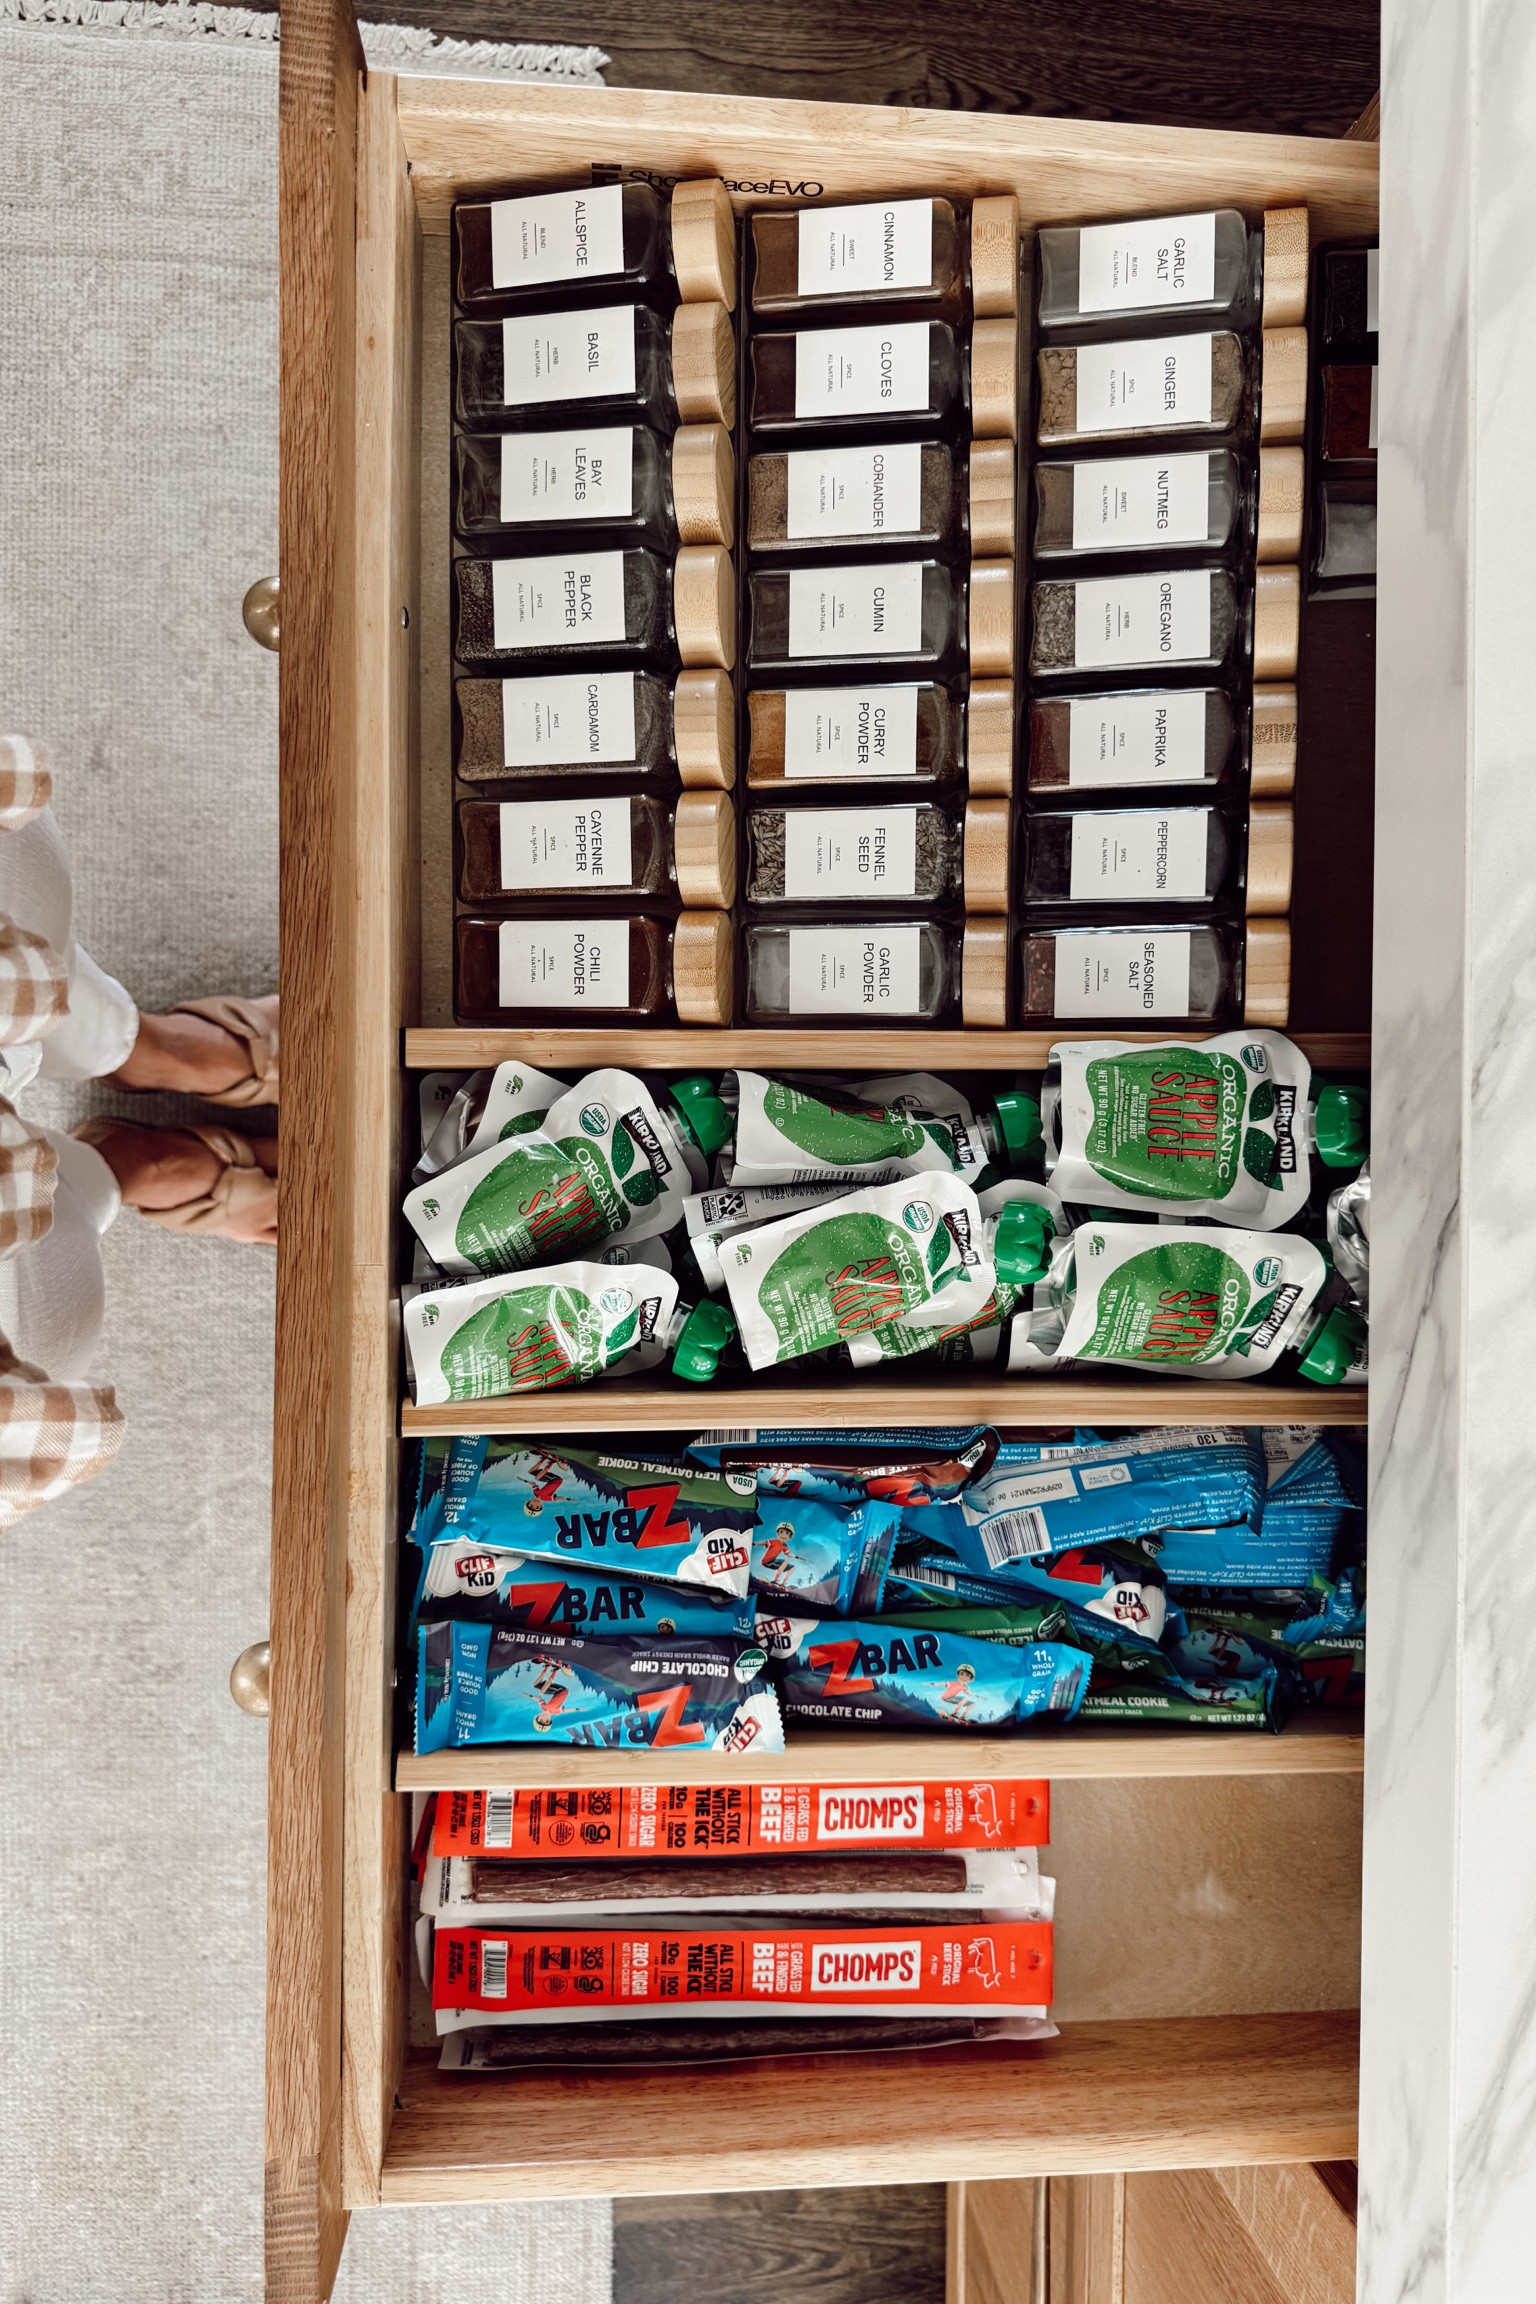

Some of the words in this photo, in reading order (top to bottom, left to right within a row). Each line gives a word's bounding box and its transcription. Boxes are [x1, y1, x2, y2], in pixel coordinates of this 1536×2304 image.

[539, 227, 547, 249] BLEND
[574, 200, 588, 267] ALLSPICE
[883, 211, 895, 282] CINNAMON
[1156, 248, 1169, 282] SALT
[1172, 237, 1186, 289] GARLIC
[587, 332, 600, 373] BASIL
[880, 341, 893, 398] CLOVES
[1163, 356, 1177, 412] GINGER
[574, 447, 587, 501] LEAVES
[590, 459, 603, 487] BAY
[871, 454, 885, 529] CORIANDER
[1120, 491, 1128, 513] SWEET
[1156, 470, 1169, 530] NUTMEG
[563, 570, 577, 629] PEPPER
[579, 574, 593, 622] BLACK
[873, 586, 886, 633] CUMIN
[1159, 582, 1172, 653] OREGANO
[587, 684, 601, 753] CARDAMOM
[1099, 722, 1107, 733] ALL
[857, 701, 870, 765] POWDER
[873, 707, 886, 758] CURRY
[1118, 732, 1126, 747] SPICE
[1154, 708, 1167, 768] PAPRIKA
[1099, 734, 1107, 761] NATURAL
[549, 835, 557, 852] SPICE
[574, 815, 588, 872] PEPPER
[590, 809, 604, 877] CAYENNE
[858, 835, 871, 873] SEED
[873, 827, 886, 882] FENNEL
[1155, 820, 1169, 889] PEPPERCORN
[573, 933, 586, 996] POWDER
[589, 946, 601, 982] CHILI
[862, 942, 875, 1003] POWDER
[878, 947, 891, 998] GARLIC
[1102, 967, 1110, 983] SPICE
[1128, 960, 1140, 991] SALT
[1143, 941, 1155, 1010] SEASONED
[1097, 1070, 1108, 1083] NET
[1098, 1085, 1108, 1096] WT
[1131, 1085, 1139, 1094] NO
[1098, 1099, 1108, 1108] 90
[1130, 1096, 1138, 1117] SUGAR
[1137, 1093, 1147, 1135] GLUTEN-FREE
[583, 1112, 601, 1133] ORGANIC
[591, 1108, 606, 1125] USDA
[1097, 1118, 1107, 1137] (3.17
[1147, 1071, 1185, 1162] SAUCE
[1181, 1072, 1219, 1163] APPLE
[1218, 1065, 1237, 1178] ORGANIC
[1096, 1140, 1106, 1153] OZ)
[574, 1147, 623, 1232] ORGANIC
[917, 1206, 930, 1223] USDA
[1270, 1264, 1280, 1281] USDA
[770, 1290, 783, 1303] NET
[811, 1293, 821, 1302] NO
[824, 1264, 872, 1339] SAUCE
[1107, 1289, 1119, 1302] NET
[1136, 1302, 1145, 1311] NO
[773, 1304, 785, 1316] WT
[812, 1303, 824, 1320] SUGAR
[1100, 1316, 1112, 1325] 90
[1104, 1304, 1115, 1314] WT
[1131, 1311, 1143, 1331] SUGAR
[1191, 1279, 1239, 1362] ORGANIC
[778, 1318, 789, 1328] 90
[1196, 1433, 1219, 1445] 130
[597, 1456, 639, 1471] COOKIE
[641, 1462, 693, 1479] OATMEAL
[732, 1475, 753, 1489] USDA
[707, 1537, 735, 1554] KiD
[459, 1557, 495, 1575] CLIF
[710, 1550, 743, 1572] CLIF
[467, 1571, 495, 1587] KiD
[516, 1633, 526, 1642] OZ
[527, 1634, 540, 1644] 1.27
[541, 1636, 553, 1645] WT
[553, 1636, 566, 1646] NET
[756, 1618, 787, 1640] CLIF
[629, 1660, 660, 1673] CHIP
[694, 1652, 711, 1661] WHOLE
[808, 1633, 943, 1698] ZBAR
[662, 1661, 729, 1678] CHOCOLATE
[458, 1686, 479, 1696] GOOD
[1127, 1697, 1169, 1708] COOKIE
[785, 1705, 853, 1718] CHOCOLATE
[855, 1708, 882, 1720] CHIP
[1207, 1714, 1220, 1723] NET
[1221, 1714, 1232, 1723] WT
[641, 1787, 657, 1812] ZERO
[695, 1787, 711, 1818] THE
[726, 1788, 741, 1810] ALL
[945, 1787, 953, 1807] BEEF
[711, 1788, 726, 1844] WITHOUT
[759, 1787, 782, 1843] BEEF
[797, 1795, 810, 1825] GRASS
[824, 1796, 919, 1832] CHOMPS
[945, 1809, 954, 1834] STICK
[953, 1788, 963, 1832] ORIGINAL
[639, 1815, 656, 1846] SUGAR
[674, 1822, 686, 1848] 100
[725, 1812, 741, 1844] STICK
[784, 1805, 795, 1842] FINISHED
[797, 1827, 810, 1841] FED
[632, 1942, 649, 1966] ZERO
[687, 1943, 703, 1972] THE
[719, 1944, 734, 1965] ALL
[943, 1942, 952, 1962] BEEF
[952, 1943, 962, 1984] ORIGINAL
[703, 1944, 718, 1993] WITHOUT
[752, 1943, 774, 1993] BEEF
[776, 1960, 787, 1992] FINISHED
[790, 1951, 803, 1979] GRASS
[818, 1952, 915, 1984] CHOMPS
[942, 1964, 951, 1986] STICK
[631, 1969, 648, 1995] SUGAR
[667, 1975, 679, 1995] 100
[718, 1967, 733, 1992] STICK
[790, 1980, 802, 1992] FED
